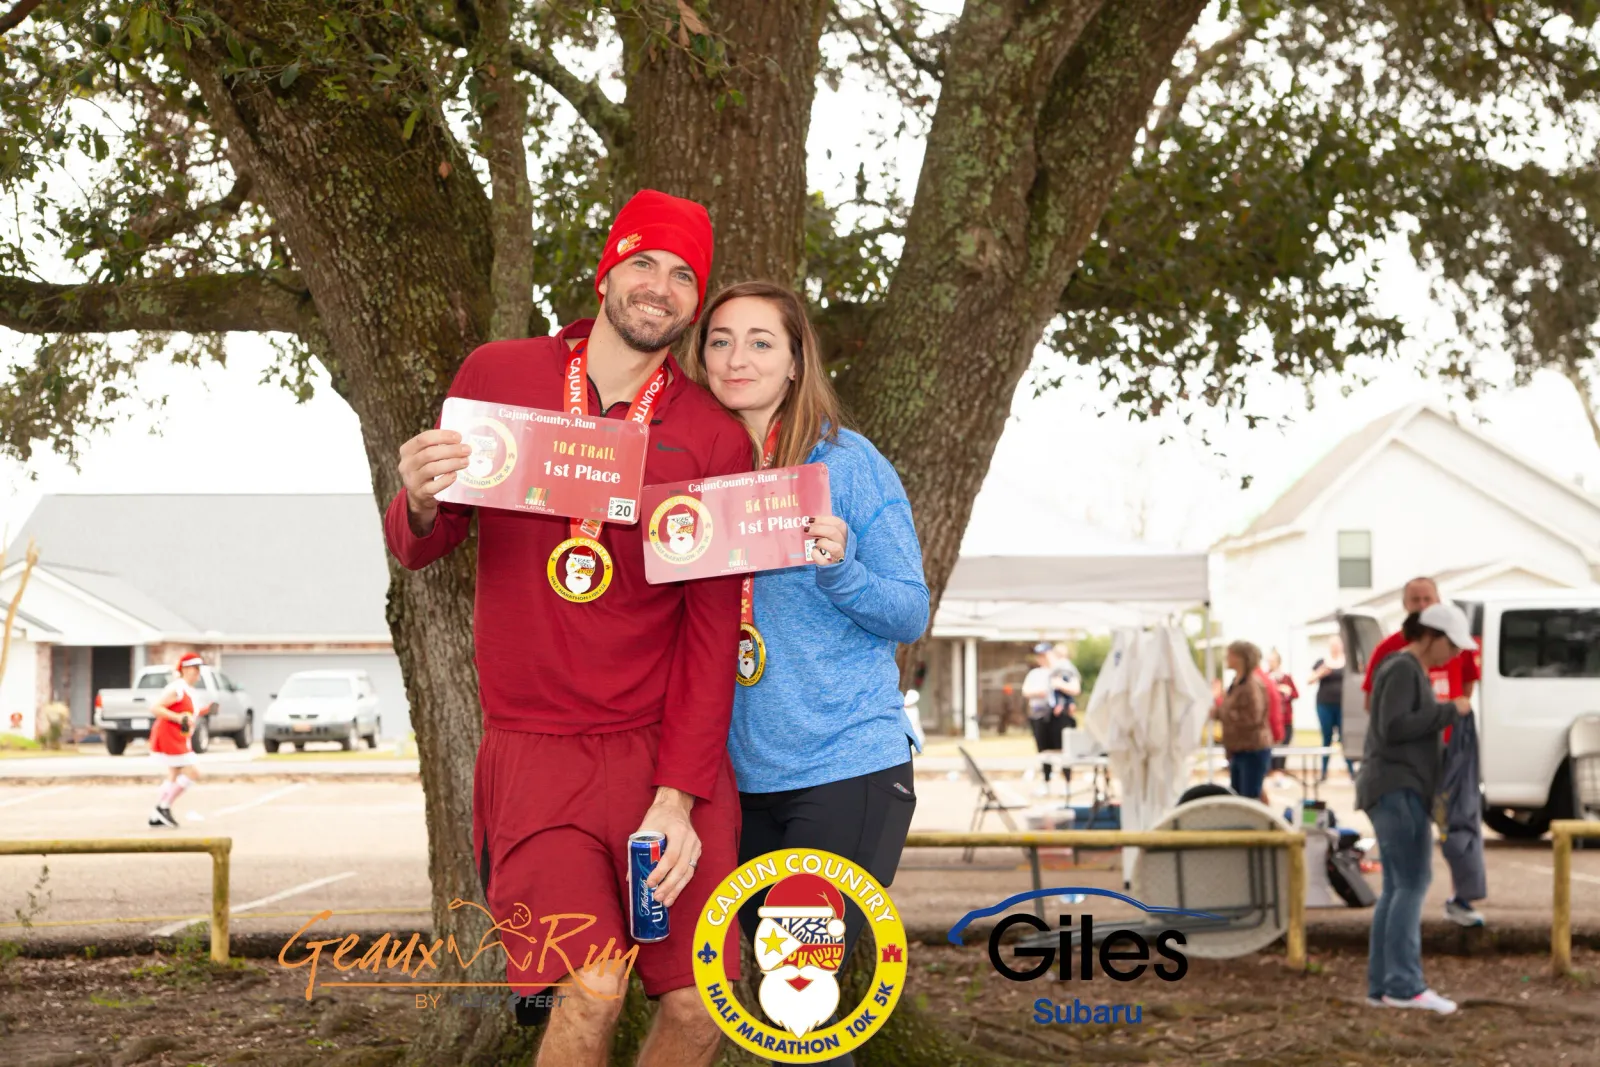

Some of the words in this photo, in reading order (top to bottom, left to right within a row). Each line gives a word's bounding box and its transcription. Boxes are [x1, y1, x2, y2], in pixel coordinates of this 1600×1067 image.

[568, 357, 582, 403] CAJUN
[632, 374, 665, 423] COUNTR
[498, 408, 597, 430] CajunCountry.Run
[553, 440, 576, 456] 10K
[580, 443, 616, 461] TRAIL
[543, 461, 570, 478] 1st
[575, 464, 621, 484] Place
[687, 473, 778, 493] CajunCountry.Run
[614, 504, 632, 517] 20
[764, 494, 799, 511] TRAIL
[738, 519, 763, 535] 1st
[767, 515, 811, 532] Place
